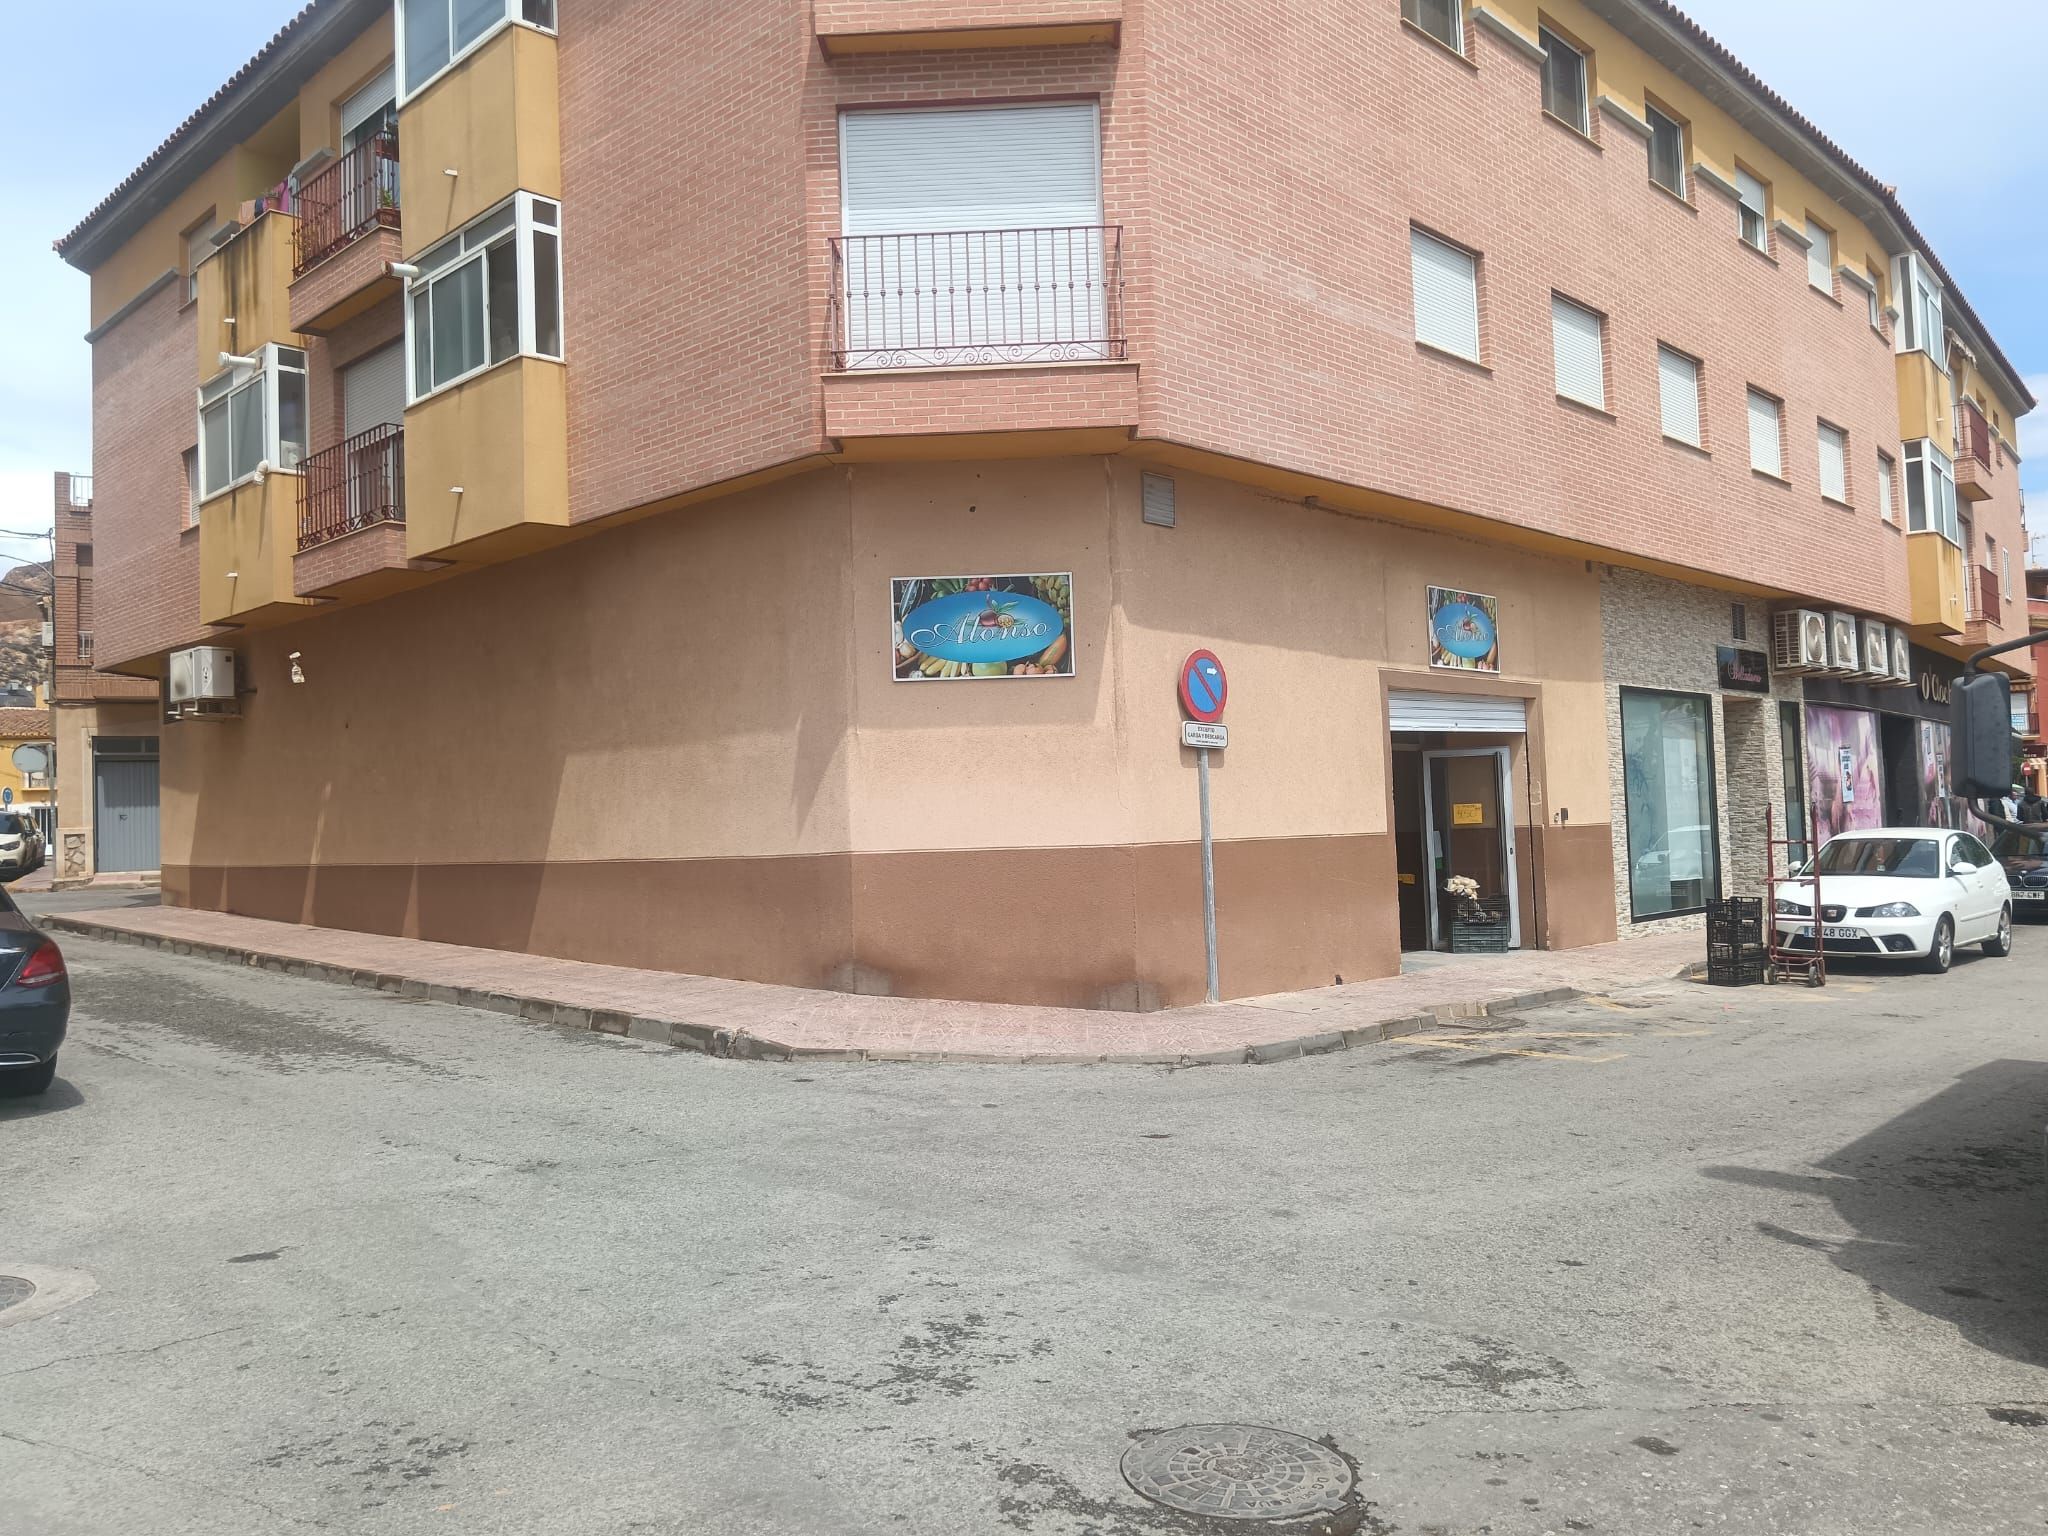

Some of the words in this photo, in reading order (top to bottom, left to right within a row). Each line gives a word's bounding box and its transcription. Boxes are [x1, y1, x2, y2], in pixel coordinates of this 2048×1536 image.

[910, 613, 1048, 648] Alonso
[1811, 927, 1835, 937] 848
[1838, 928, 1858, 938] GGX
[1246, 1497, 1292, 1508] AUA
